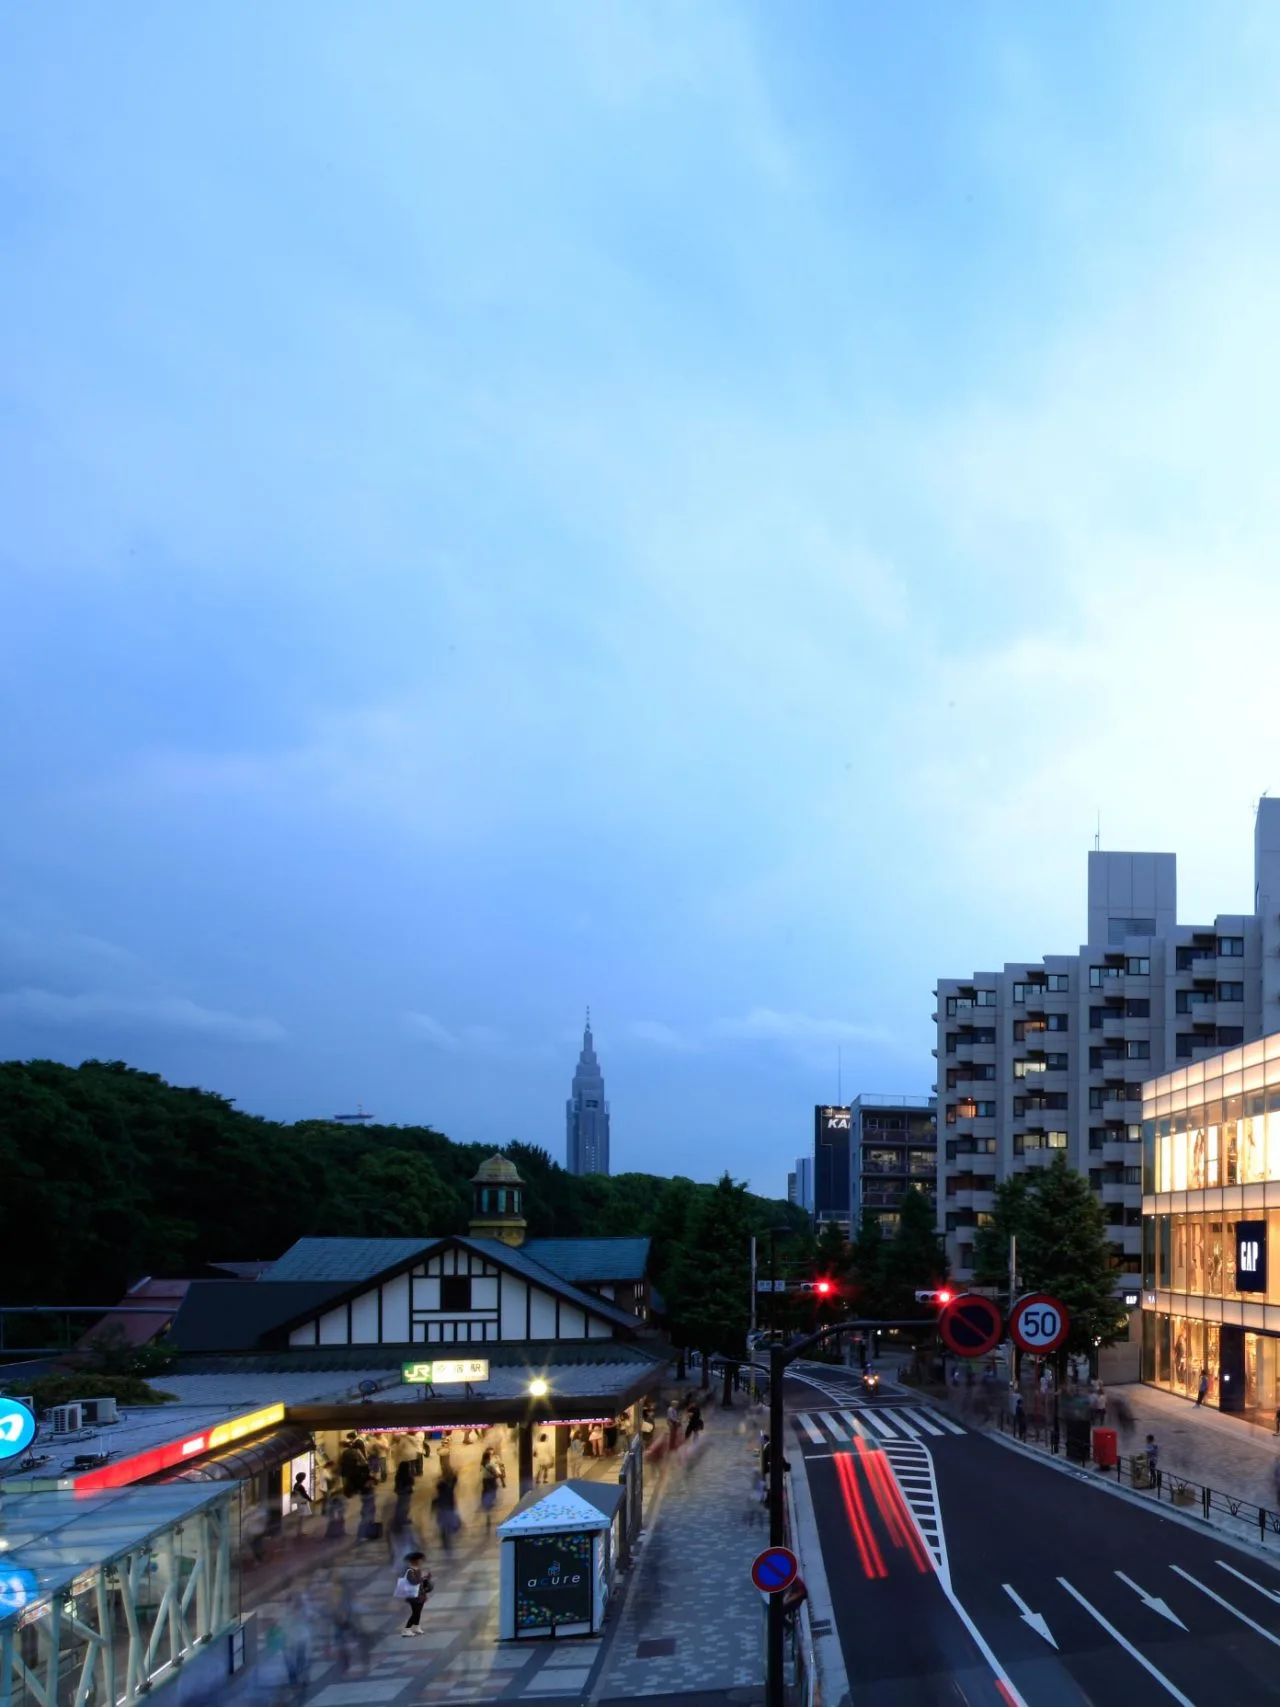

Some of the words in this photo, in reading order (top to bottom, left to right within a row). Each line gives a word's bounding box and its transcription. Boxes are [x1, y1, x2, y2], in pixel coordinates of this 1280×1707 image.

[1240, 1241, 1259, 1271] GAP
[1024, 1311, 1057, 1338] 50
[404, 1364, 430, 1379] JR
[527, 1574, 581, 1588] acure
